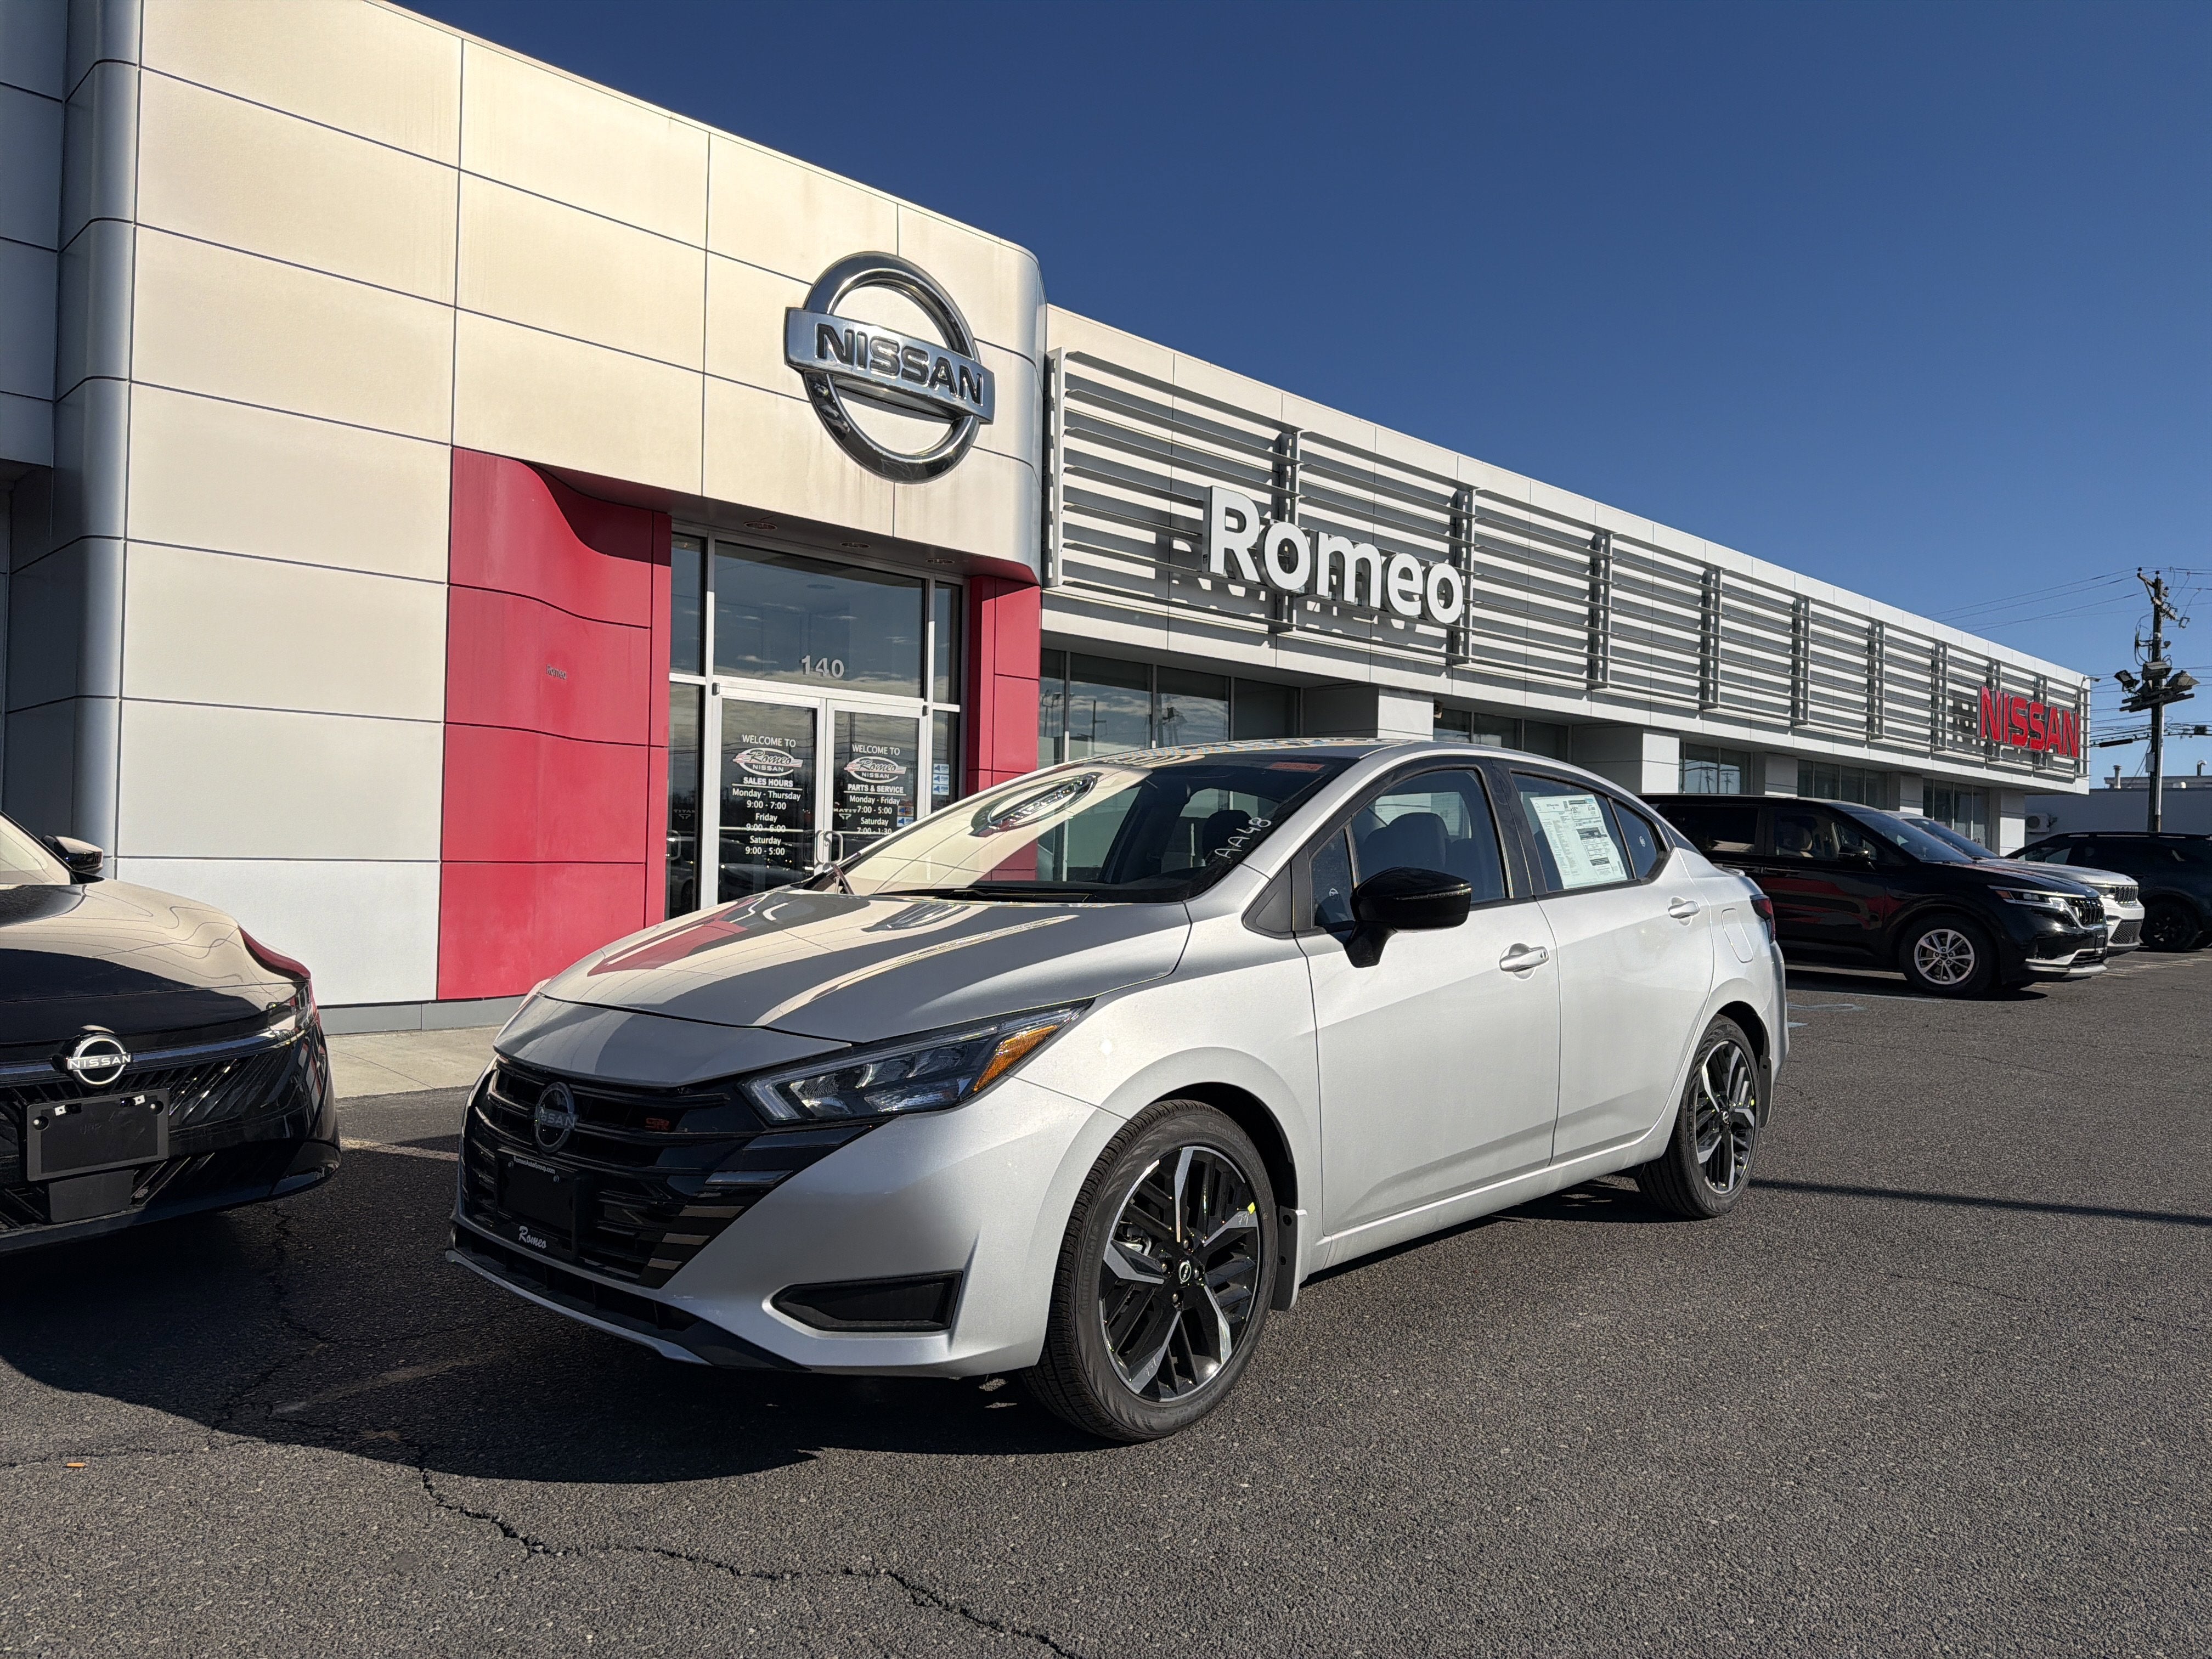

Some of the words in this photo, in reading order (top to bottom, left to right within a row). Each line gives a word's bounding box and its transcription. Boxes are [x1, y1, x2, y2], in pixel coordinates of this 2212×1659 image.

[814, 322, 984, 407] NISSAN
[1207, 486, 1463, 625] Romeo
[802, 655, 844, 678] 140
[1980, 686, 2079, 758] NISSAN
[742, 734, 783, 747] WELCOME
[785, 738, 796, 747] TO
[852, 744, 888, 755] WELCOME
[889, 747, 900, 756] TO
[747, 749, 792, 765] Romeo
[858, 758, 896, 772] Romeo
[743, 776, 767, 786] SALES
[768, 778, 793, 788] HOURS
[848, 783, 868, 792] PARTS
[732, 788, 762, 799] Monday
[768, 790, 801, 802] Thursday
[849, 795, 876, 805] Monday
[881, 797, 900, 806] Friday
[746, 800, 764, 809] 9:00
[770, 802, 787, 810] 7:00
[856, 805, 872, 814] 7:00
[878, 806, 893, 815] 5:00
[755, 812, 778, 823] Friday
[860, 817, 889, 827] Saturday
[746, 823, 763, 832] 9:00
[769, 825, 786, 833] 6:00
[749, 836, 782, 846] Saturday
[1214, 816, 1272, 859] AA48
[745, 847, 762, 855] 9:00
[769, 847, 786, 856] 5:00
[67, 1053, 131, 1069] NISSAN
[518, 1226, 547, 1249] Romeo
